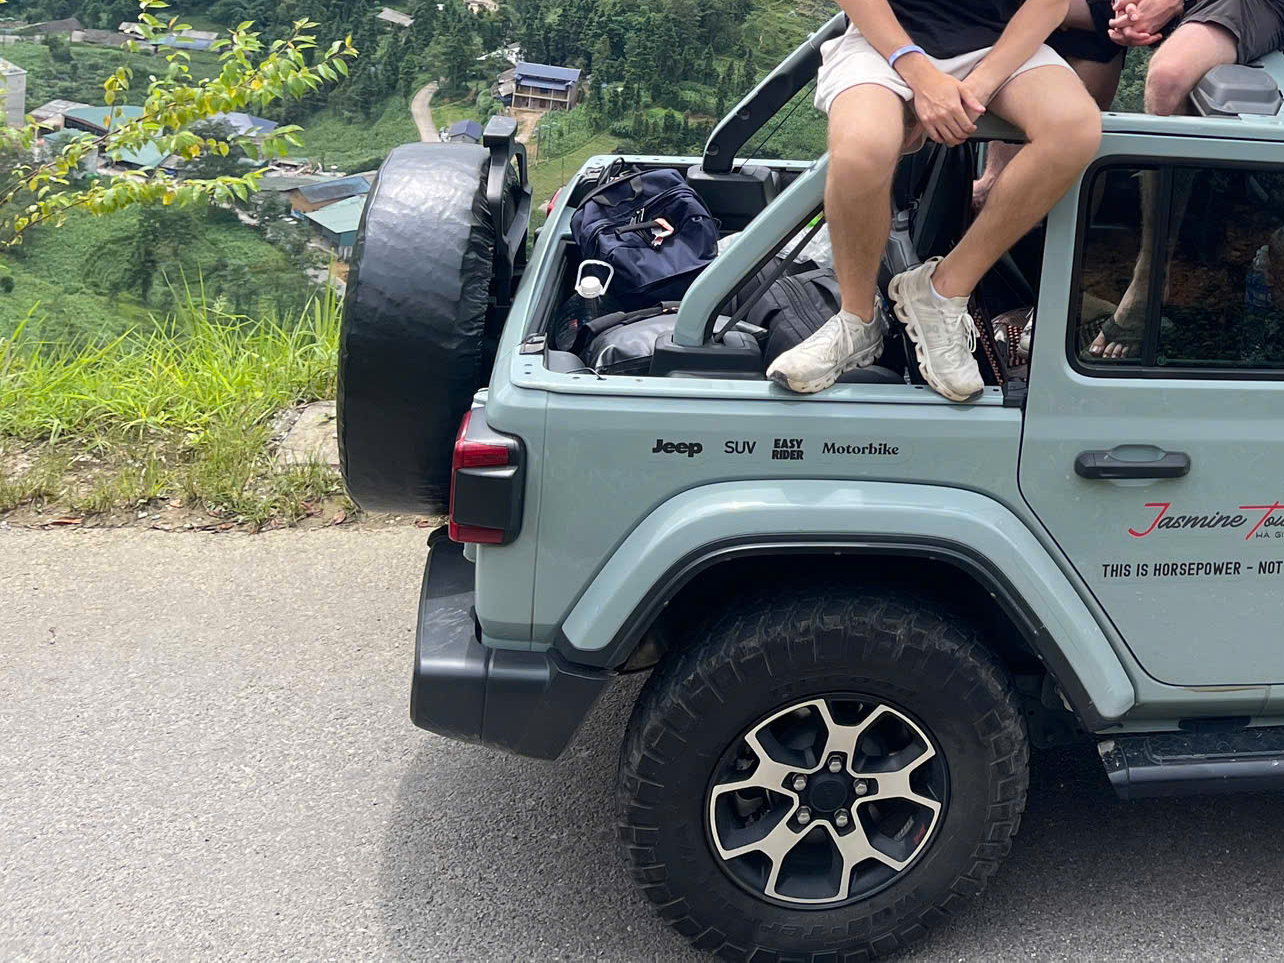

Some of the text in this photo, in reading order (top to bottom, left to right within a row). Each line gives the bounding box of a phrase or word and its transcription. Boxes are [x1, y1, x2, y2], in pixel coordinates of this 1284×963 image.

[652, 439, 703, 458] Jeep
[724, 441, 757, 455] SUV
[773, 438, 804, 449] EASY
[822, 442, 900, 456] Motorbike
[772, 449, 804, 461] RIDER
[1128, 502, 1247, 538] Jasmine
[1255, 531, 1270, 539] HA
[1102, 563, 1132, 578] THIS
[1136, 563, 1149, 577] IS
[1153, 561, 1242, 577] HORSEPOWER
[1258, 560, 1284, 575] NOT
